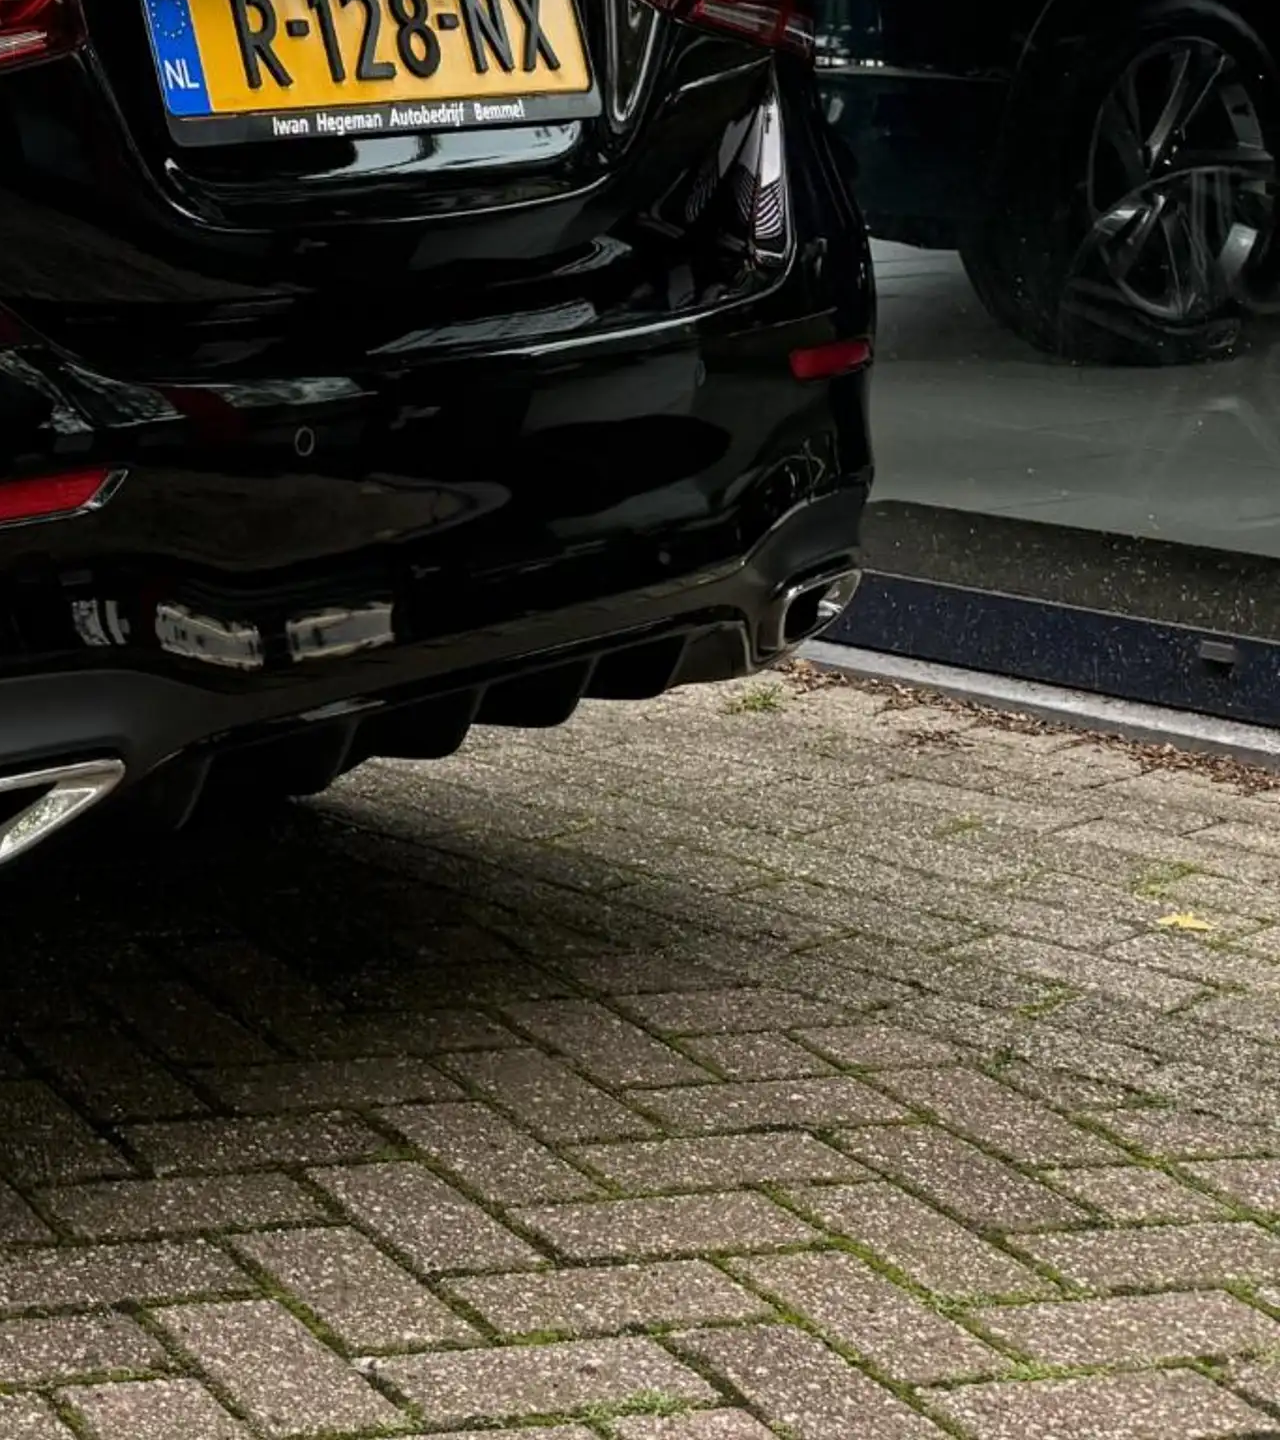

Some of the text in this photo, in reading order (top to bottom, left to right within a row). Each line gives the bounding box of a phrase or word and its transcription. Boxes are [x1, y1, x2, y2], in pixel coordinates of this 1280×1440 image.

[165, 58, 200, 89] NL
[273, 99, 526, 136] Iwan Hegeman Autobedrijf Bemmel
